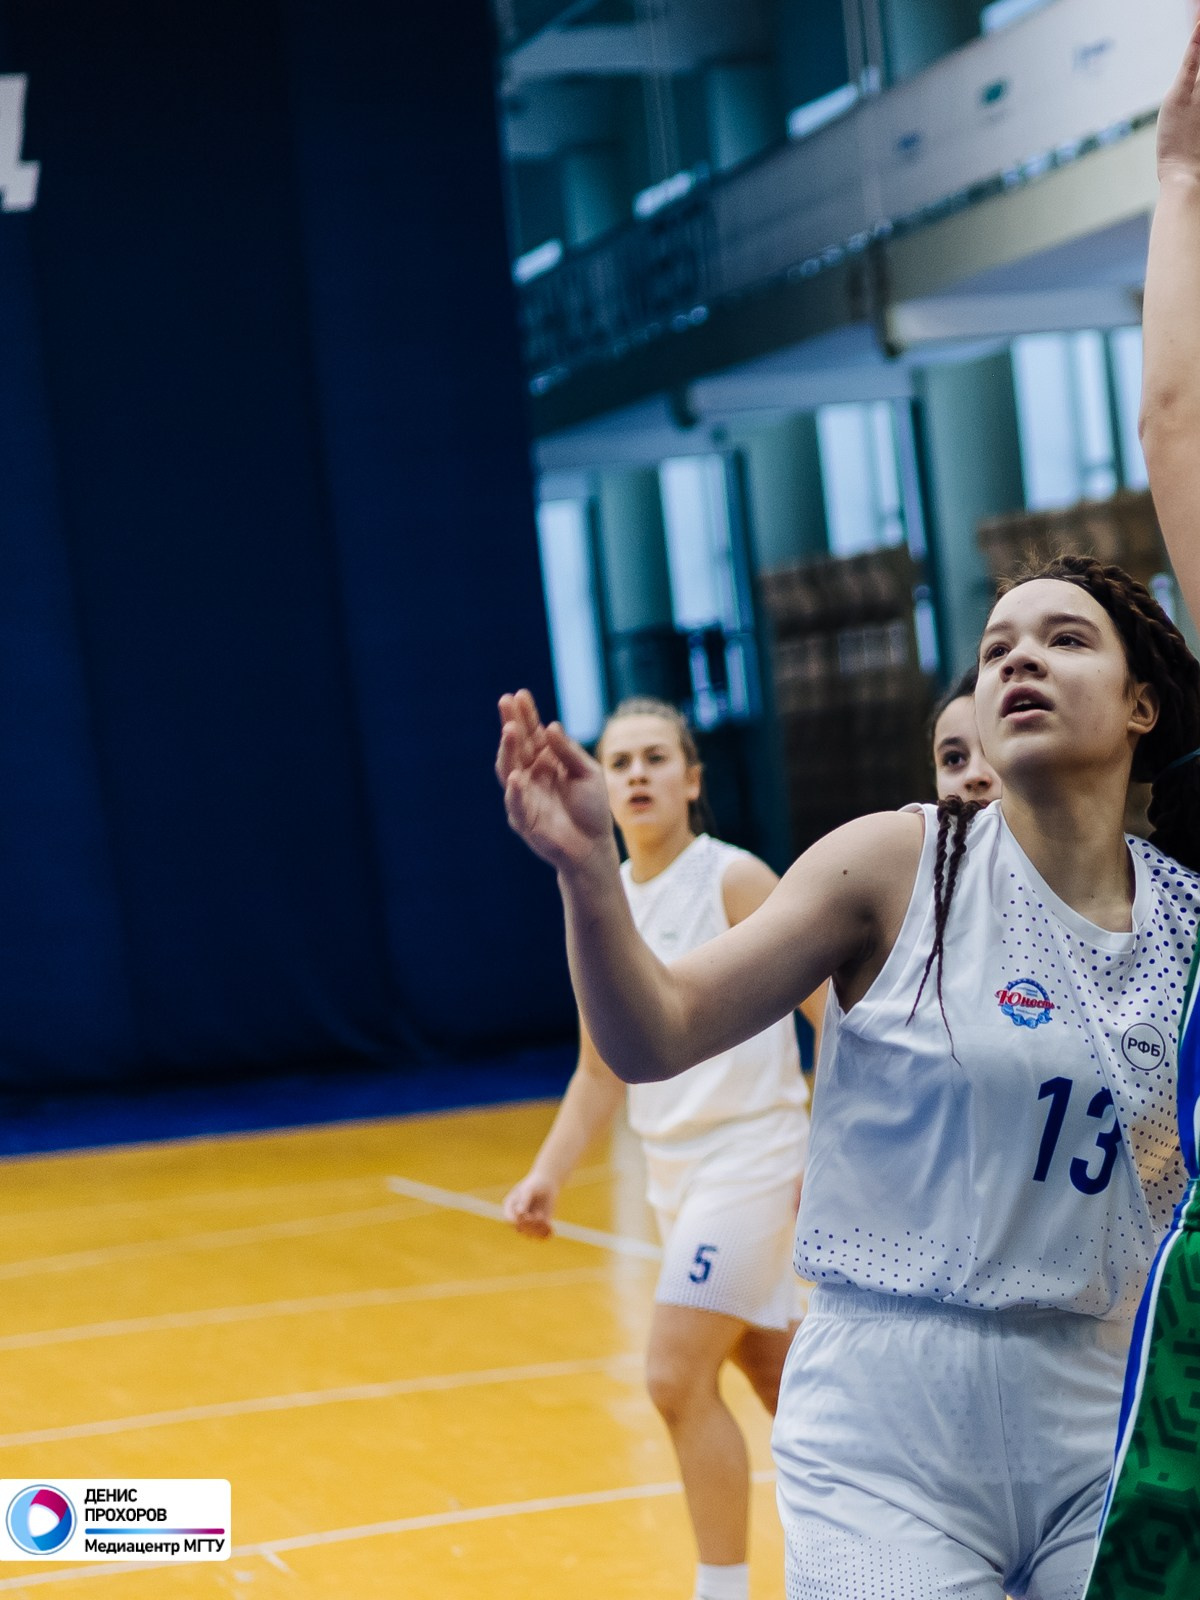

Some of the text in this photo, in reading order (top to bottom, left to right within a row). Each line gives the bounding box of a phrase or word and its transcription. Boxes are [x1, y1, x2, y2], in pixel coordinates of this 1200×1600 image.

[994, 989, 1056, 1010] Юность
[1127, 1036, 1161, 1058] РФБ
[1032, 1076, 1122, 1196] 13
[688, 1243, 719, 1284] 5
